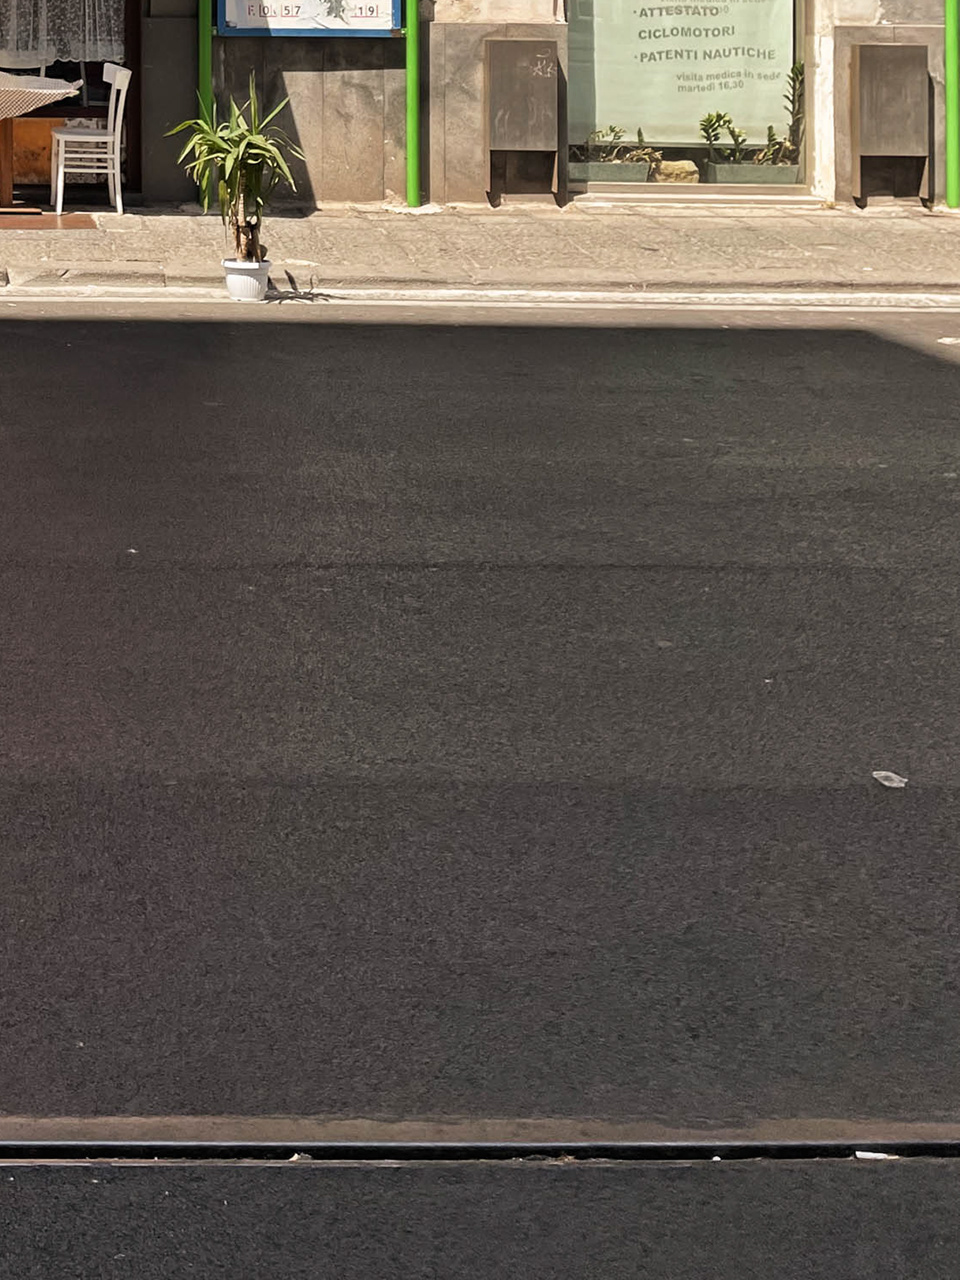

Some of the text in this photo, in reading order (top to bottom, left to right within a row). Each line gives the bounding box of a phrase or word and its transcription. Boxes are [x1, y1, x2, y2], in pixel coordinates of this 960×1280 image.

[639, 4, 720, 18] ATTESTATO
[638, 25, 736, 40] CICLOMOTORI
[640, 46, 776, 63] PATENTI NAUTICHE
[676, 71, 704, 82] visita
[706, 70, 742, 81] medica
[744, 68, 754, 79] in
